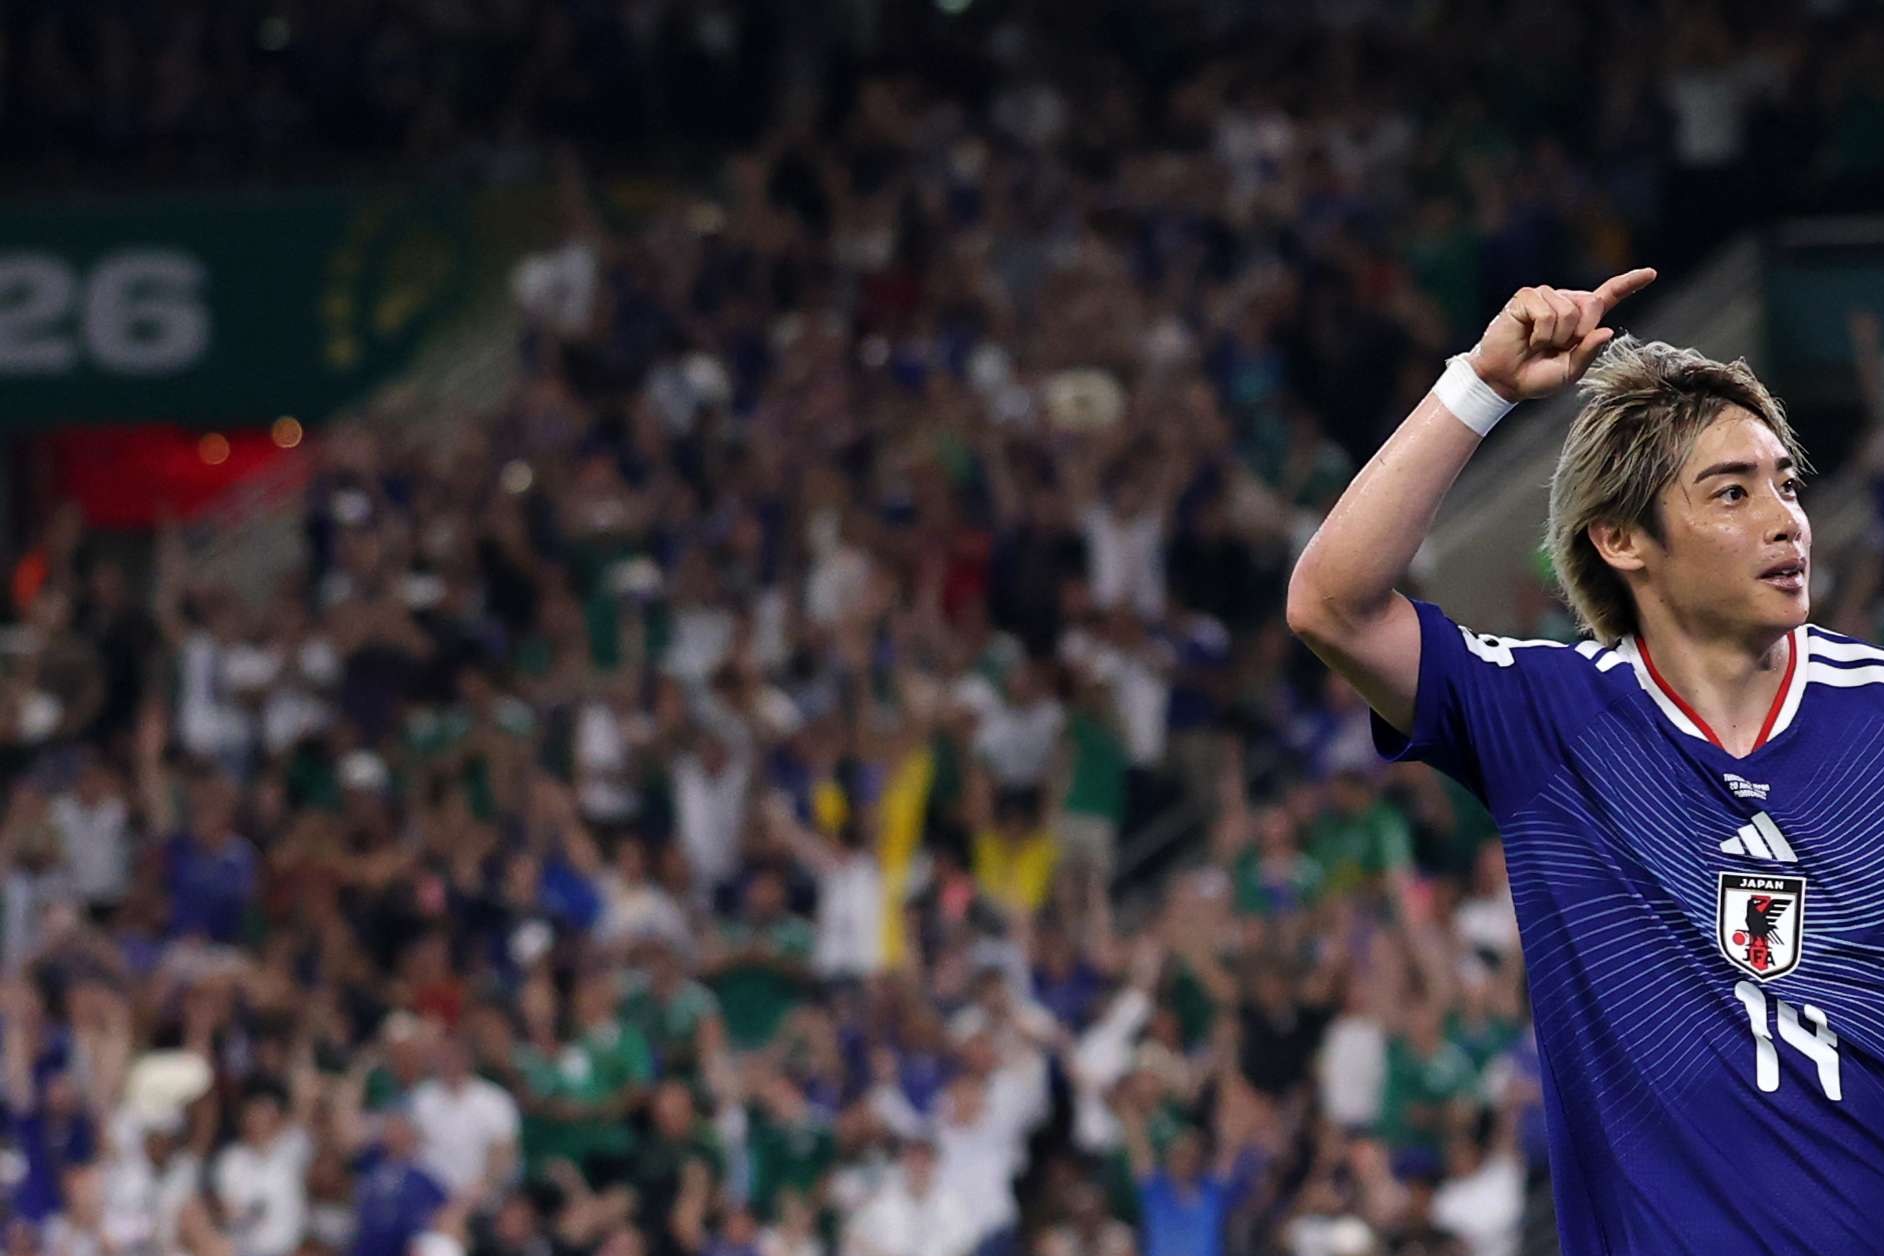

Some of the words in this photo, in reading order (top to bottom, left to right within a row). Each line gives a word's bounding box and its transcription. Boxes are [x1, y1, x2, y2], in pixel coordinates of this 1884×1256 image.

[0, 249, 212, 376] 26
[1739, 878, 1785, 890] JAPAN
[1742, 947, 1776, 967] JFA
[1734, 980, 1842, 1101] 14
